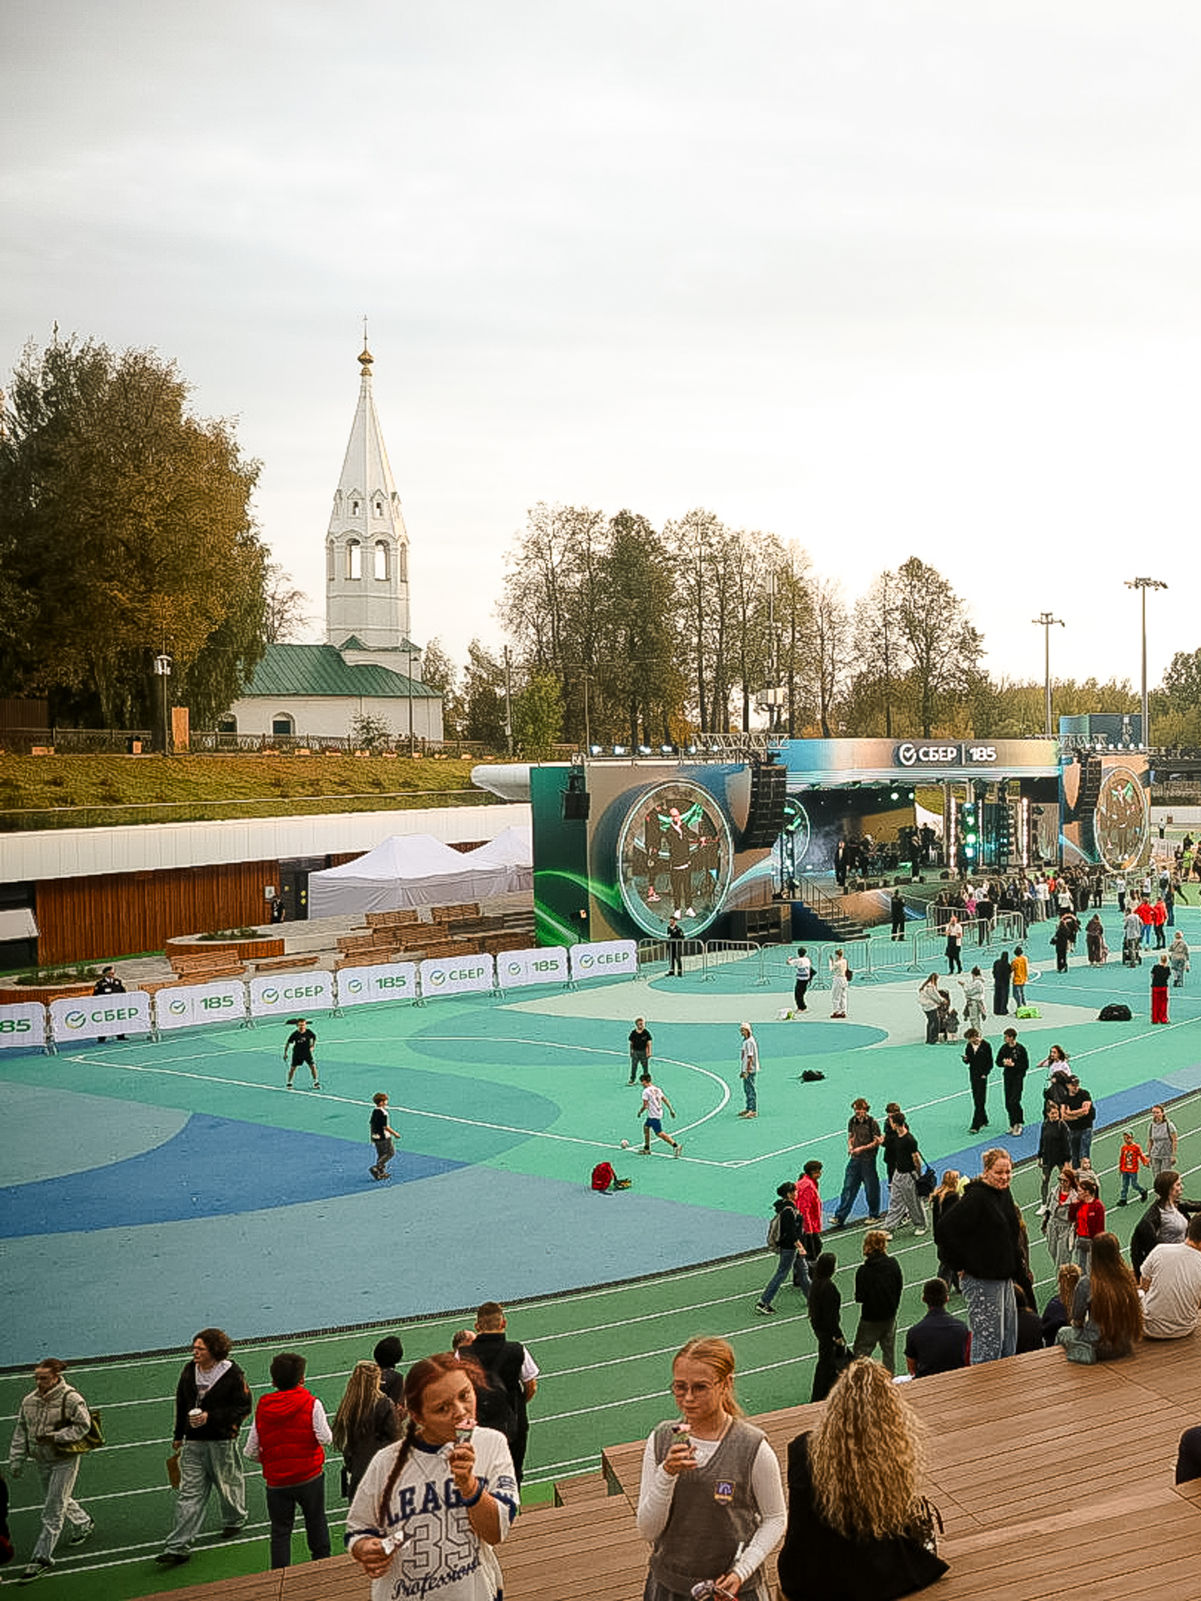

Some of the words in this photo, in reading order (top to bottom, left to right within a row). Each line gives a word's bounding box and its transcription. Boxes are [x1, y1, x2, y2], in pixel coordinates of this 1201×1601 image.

[918, 746, 957, 761] СБЕР
[969, 746, 997, 761] 185
[532, 960, 560, 972] 185
[597, 953, 630, 965] СБЕР
[449, 967, 485, 981] СБЕР
[375, 976, 406, 989] 185
[283, 985, 324, 999] СБЕР
[201, 995, 235, 1010] 185
[91, 1007, 139, 1023] СБЕР
[0, 1018, 32, 1033] 85
